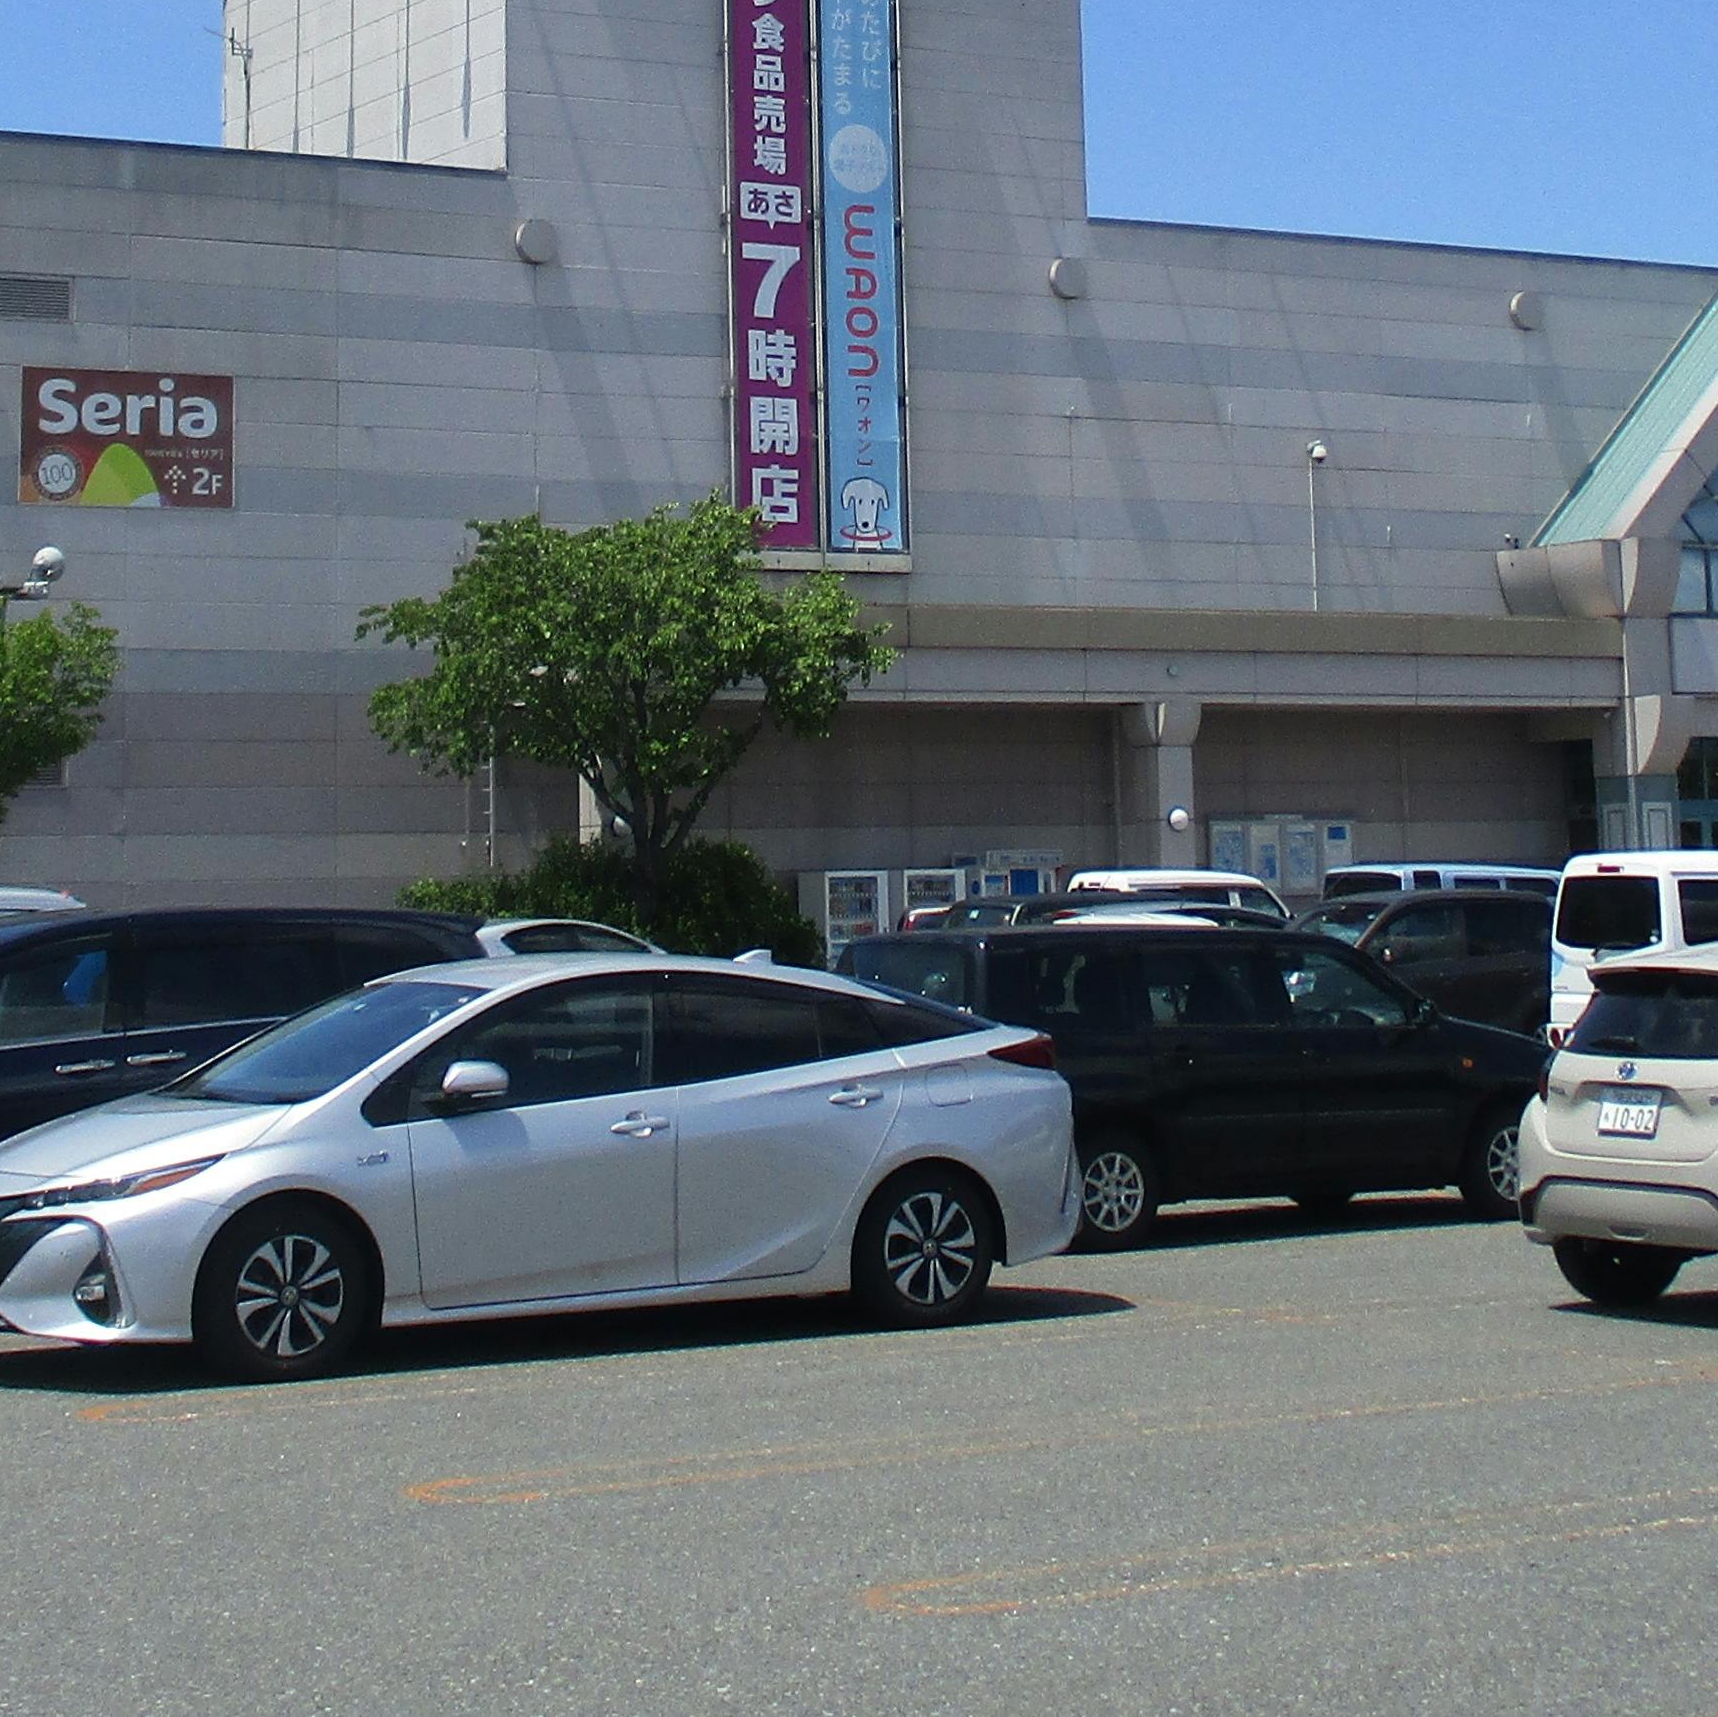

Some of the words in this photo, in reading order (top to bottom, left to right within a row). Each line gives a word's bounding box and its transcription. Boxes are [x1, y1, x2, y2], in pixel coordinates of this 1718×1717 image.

[746, 187, 796, 218] あさ
[741, 242, 801, 524] 7時開店
[38, 377, 218, 439] Seria
[41, 462, 73, 486] 100
[192, 467, 223, 495] 2F
[1611, 1108, 1654, 1131] 10-02
